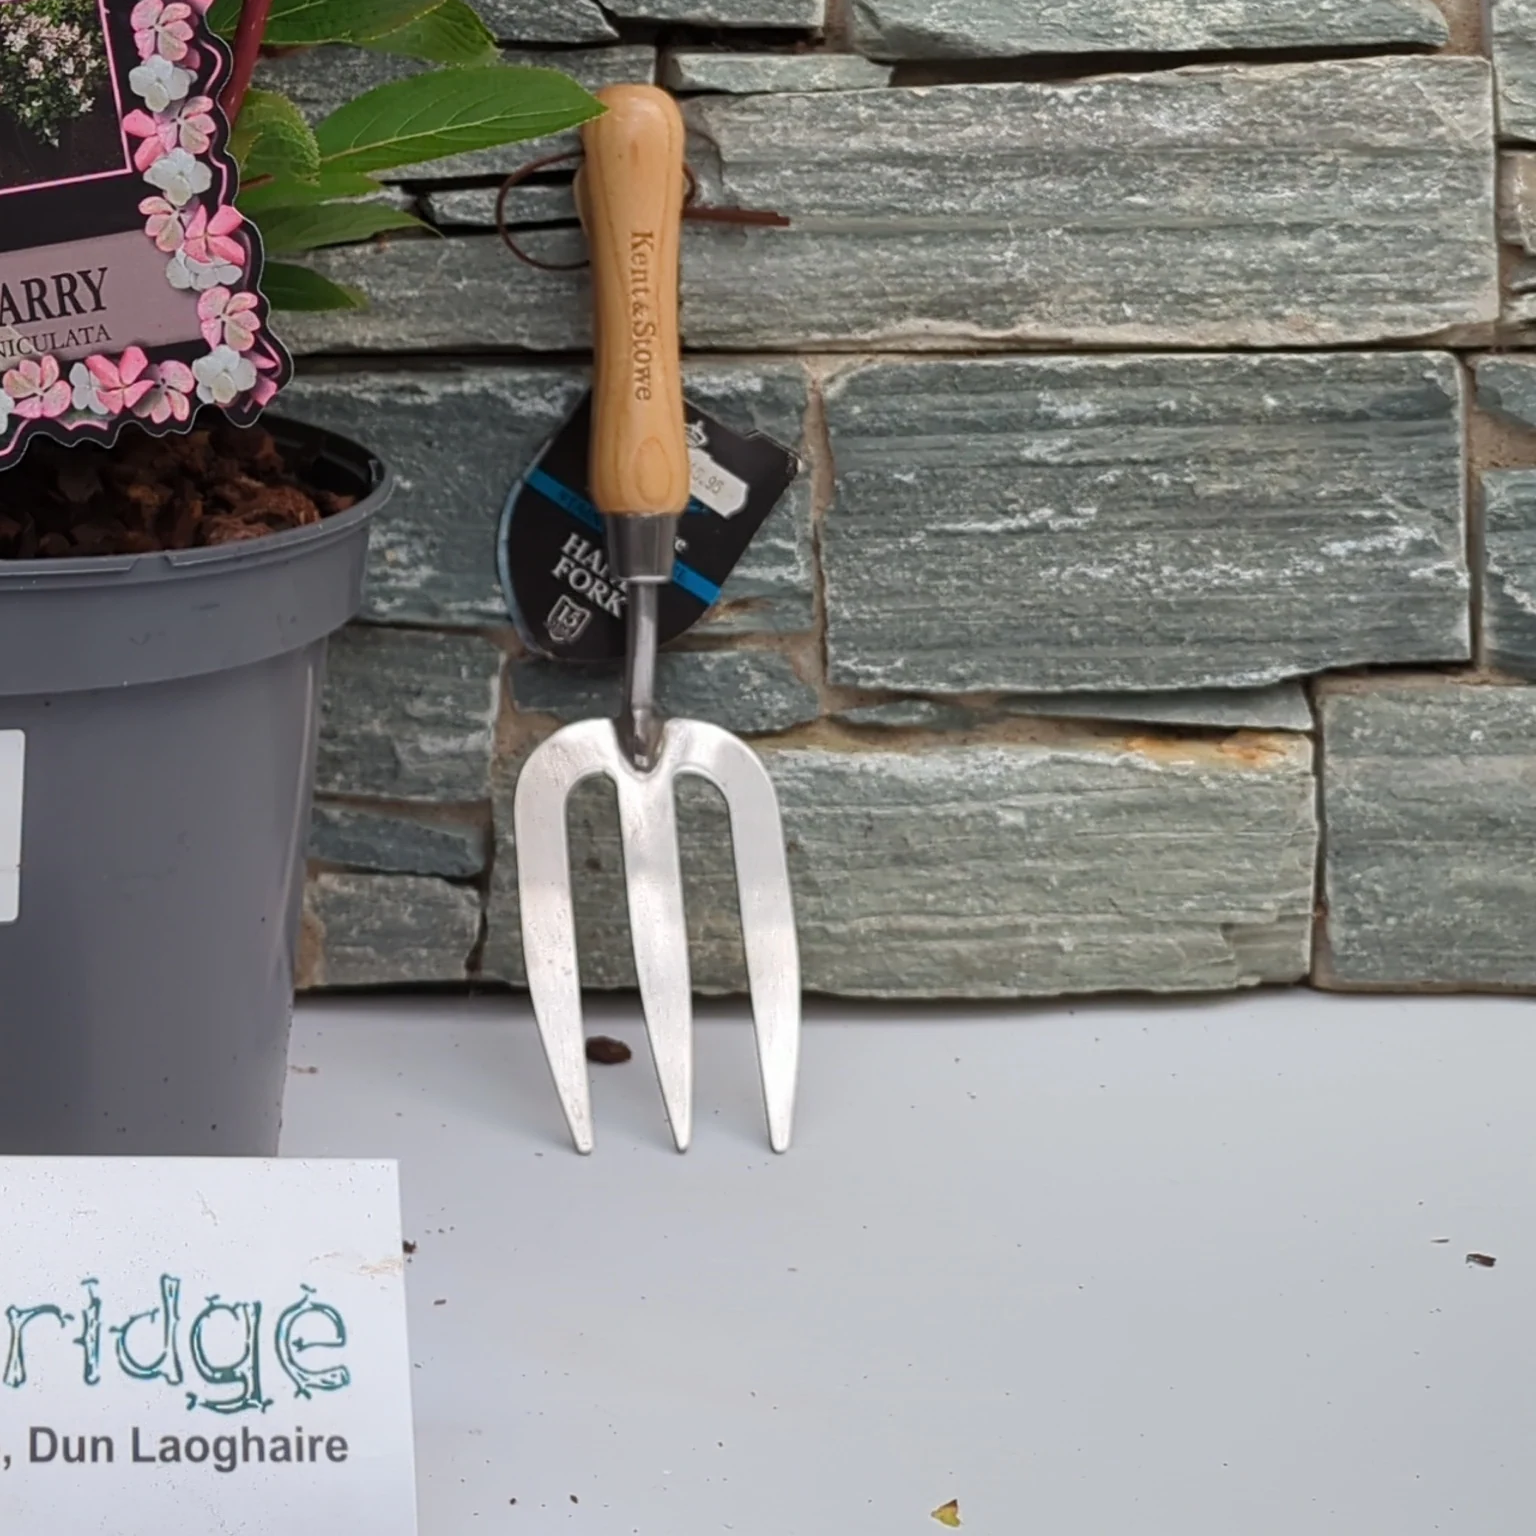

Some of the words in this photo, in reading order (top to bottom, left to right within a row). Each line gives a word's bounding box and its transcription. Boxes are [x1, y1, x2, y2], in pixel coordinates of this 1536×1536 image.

[630, 230, 654, 297] Kent
[632, 321, 656, 401] Stowe
[551, 556, 627, 618] FORK
[28, 1425, 113, 1464] Dun
[131, 1425, 350, 1473] Laoghaire
